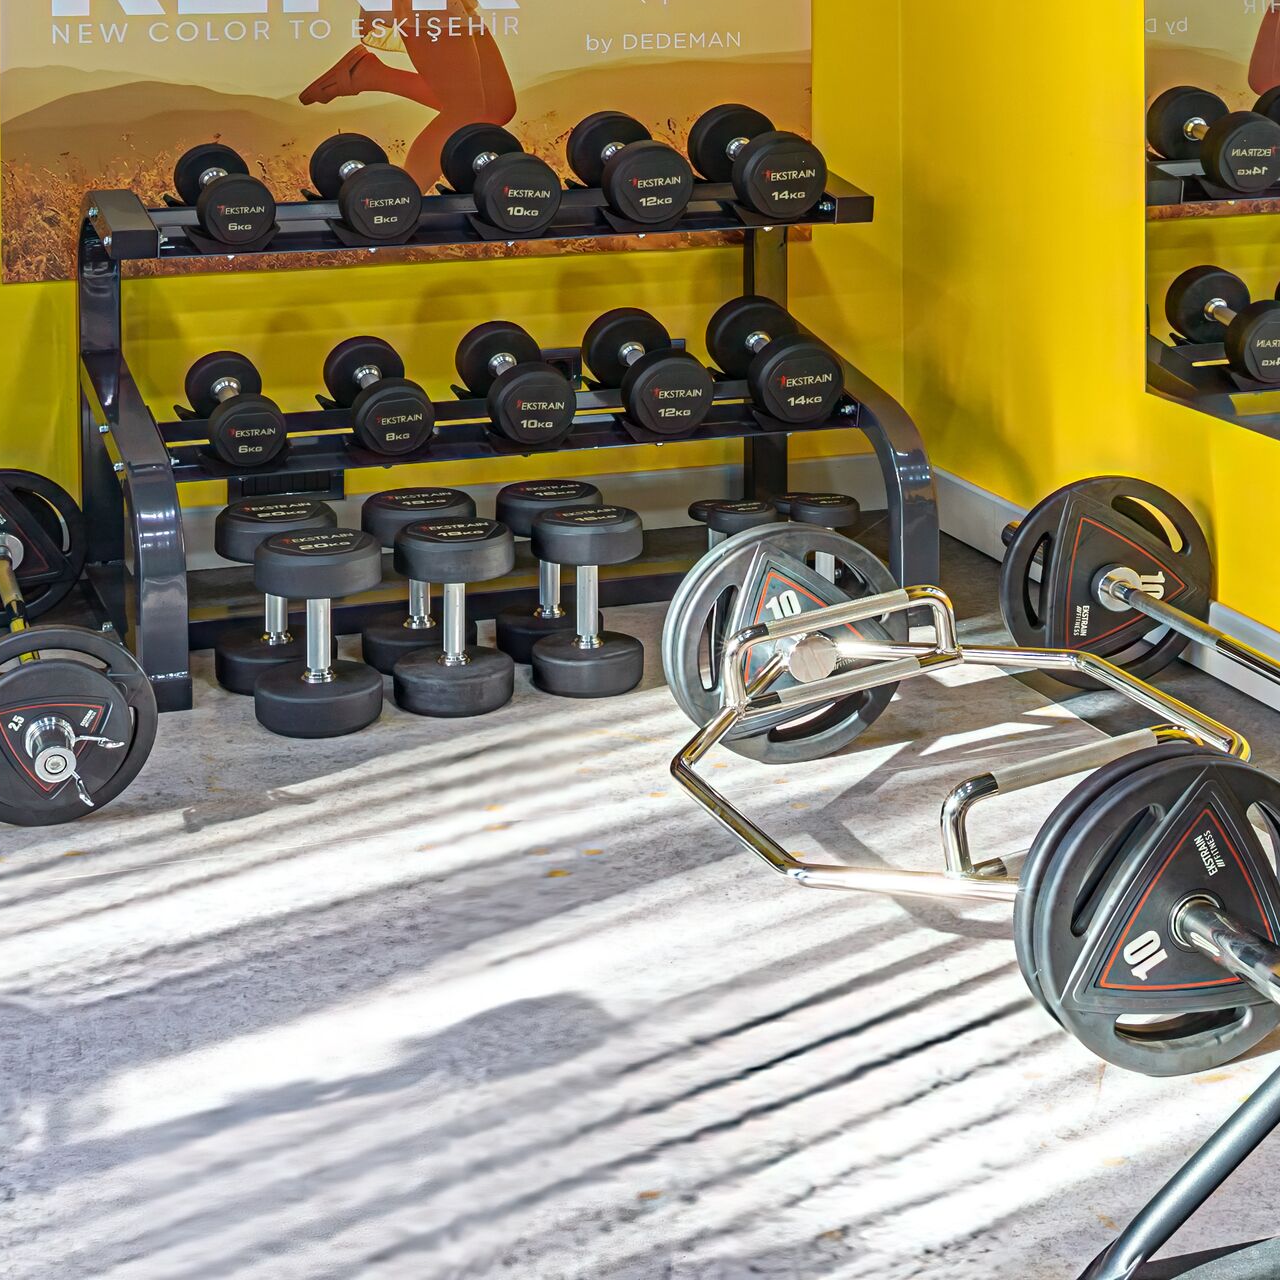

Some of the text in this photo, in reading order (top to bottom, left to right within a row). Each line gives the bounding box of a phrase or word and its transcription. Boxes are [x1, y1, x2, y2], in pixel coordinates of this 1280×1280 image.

[52, 11, 519, 45] NEW COLOR TO ESKİŞEHİR
[586, 31, 741, 54] by DEDEMAN
[1140, 571, 1166, 600] 10
[765, 590, 802, 620] 10
[1194, 835, 1218, 876] EKSTRAIN
[1123, 930, 1169, 982] 10
